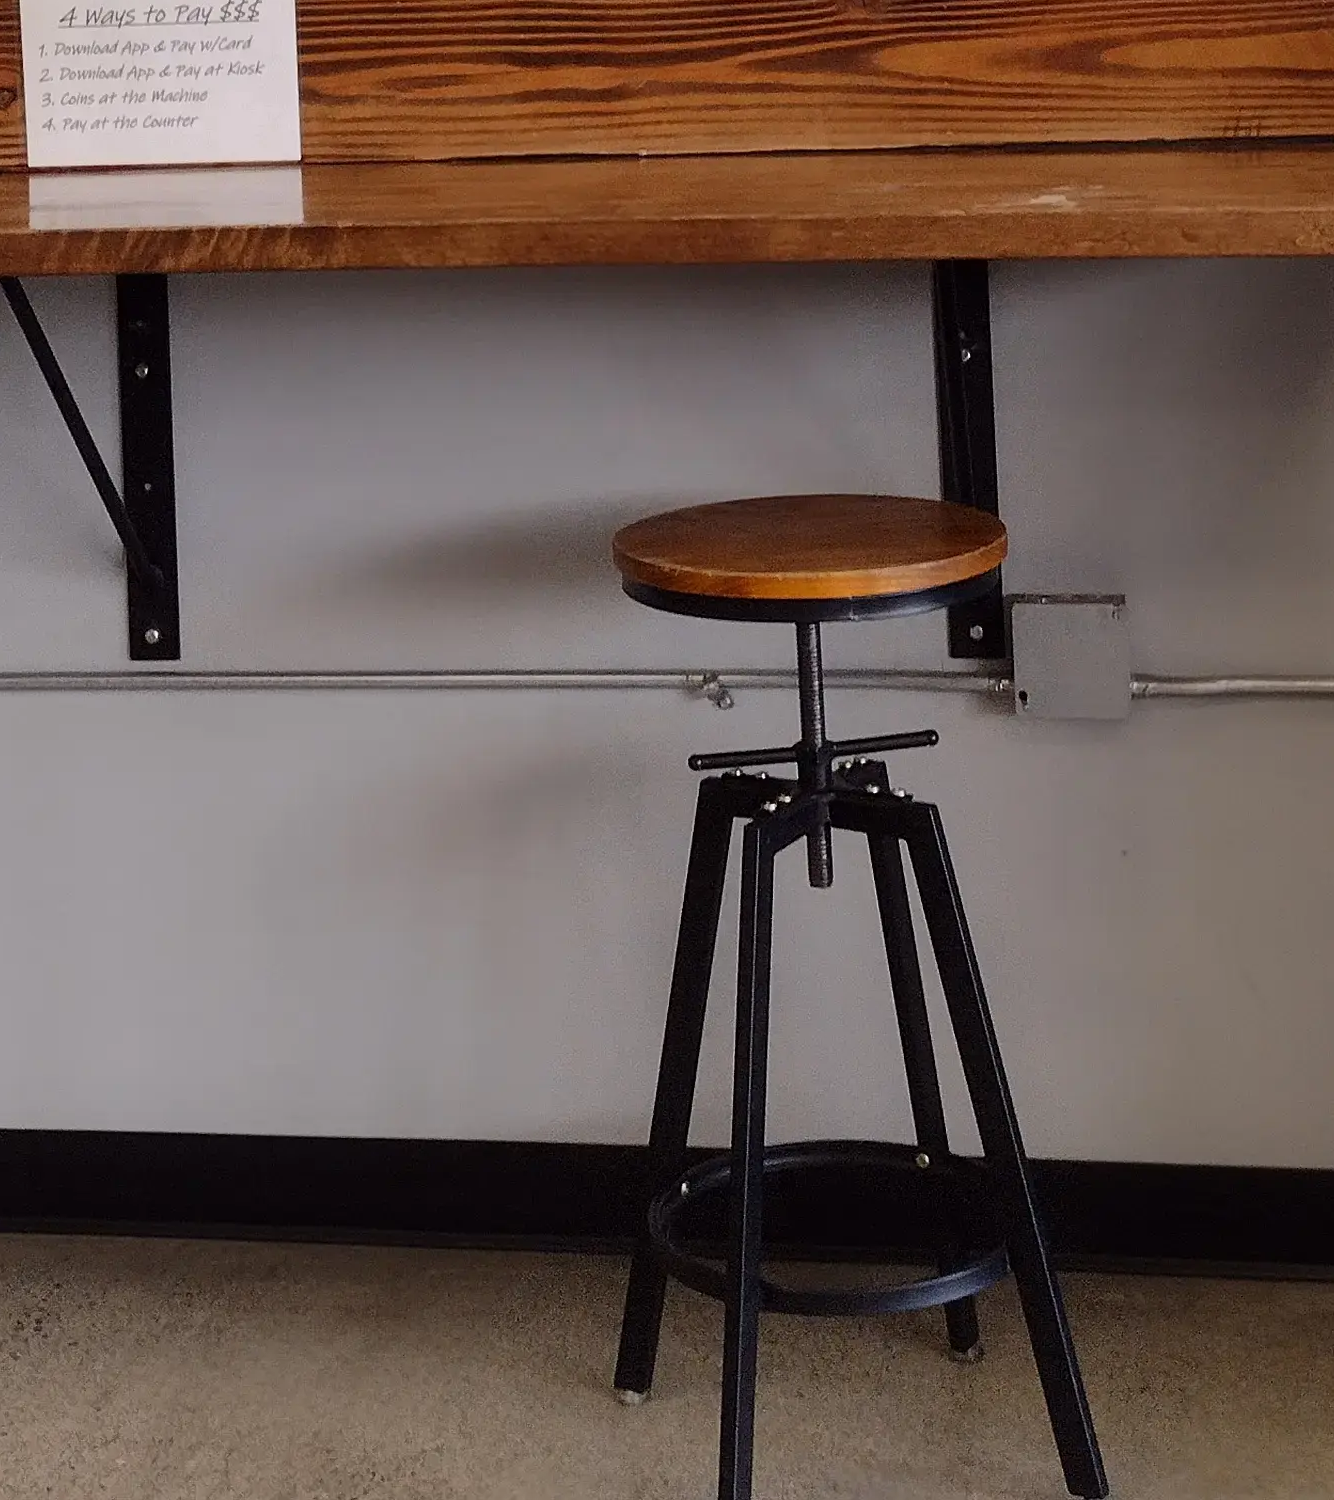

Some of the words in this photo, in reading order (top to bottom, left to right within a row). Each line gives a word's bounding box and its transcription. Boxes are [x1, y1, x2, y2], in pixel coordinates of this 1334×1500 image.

[58, 6, 77, 27] 4
[85, 7, 136, 28] Ways
[143, 5, 166, 24] to
[174, 4, 213, 25] Pay
[38, 44, 48, 59] 1.
[54, 40, 118, 56] Download
[122, 40, 150, 58] App
[153, 40, 166, 53] &
[171, 39, 196, 56] Pay
[200, 35, 253, 52] w/Card
[39, 69, 53, 83] 2.
[59, 65, 123, 82] Download
[126, 65, 155, 83] App
[158, 64, 171, 78] &
[176, 64, 201, 81] Pay
[204, 63, 223, 77] at
[227, 60, 266, 76] Kiosk
[41, 94, 54, 107] 3.
[60, 92, 95, 106] Coins
[98, 91, 118, 105] at
[122, 89, 146, 104] the
[151, 88, 208, 103] Machine
[42, 118, 56, 132] 4.
[62, 117, 87, 134] Pay
[90, 116, 110, 130] at
[113, 114, 138, 129] the
[142, 115, 199, 129] Counter
